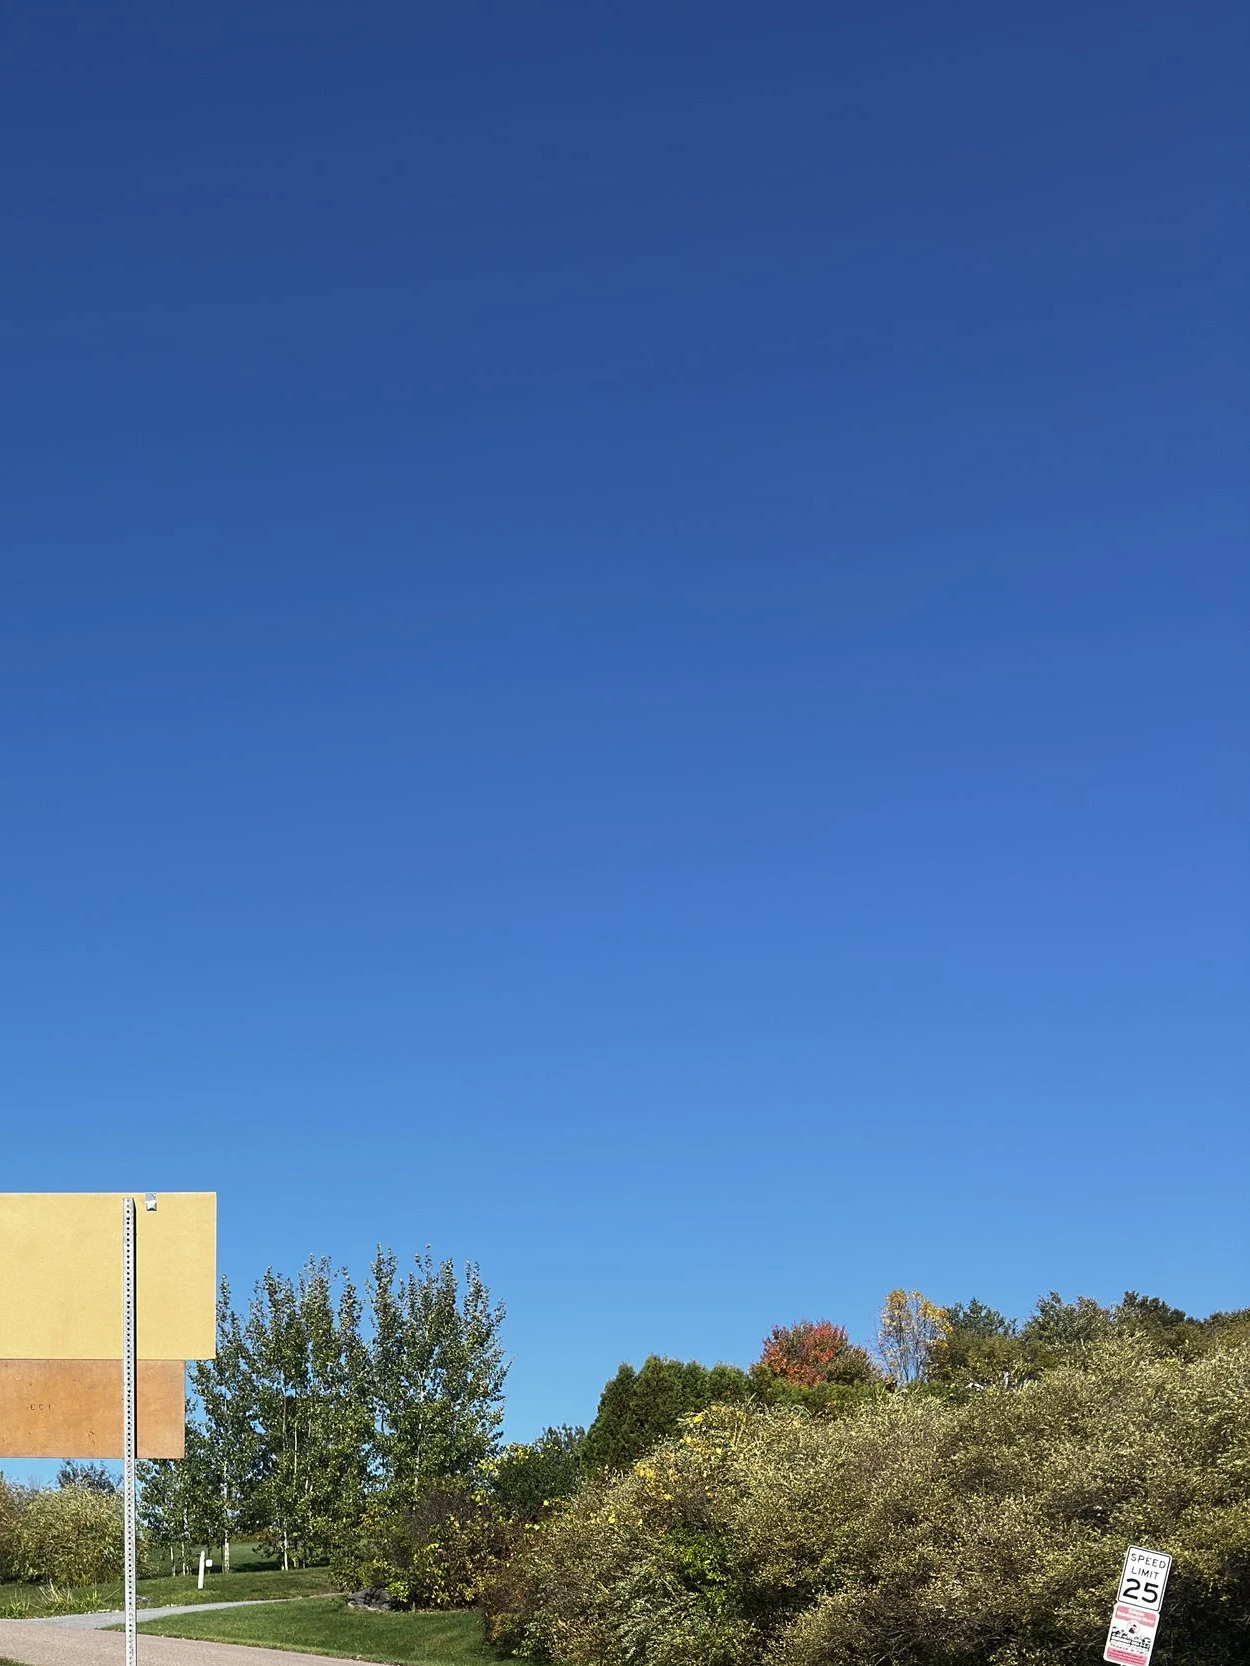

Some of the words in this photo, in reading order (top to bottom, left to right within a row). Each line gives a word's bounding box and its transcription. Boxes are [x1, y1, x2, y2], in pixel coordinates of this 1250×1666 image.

[1130, 1553, 1167, 1569] SPEED
[1131, 1566, 1160, 1580] LIMIT
[1122, 1578, 1159, 1603] 25
